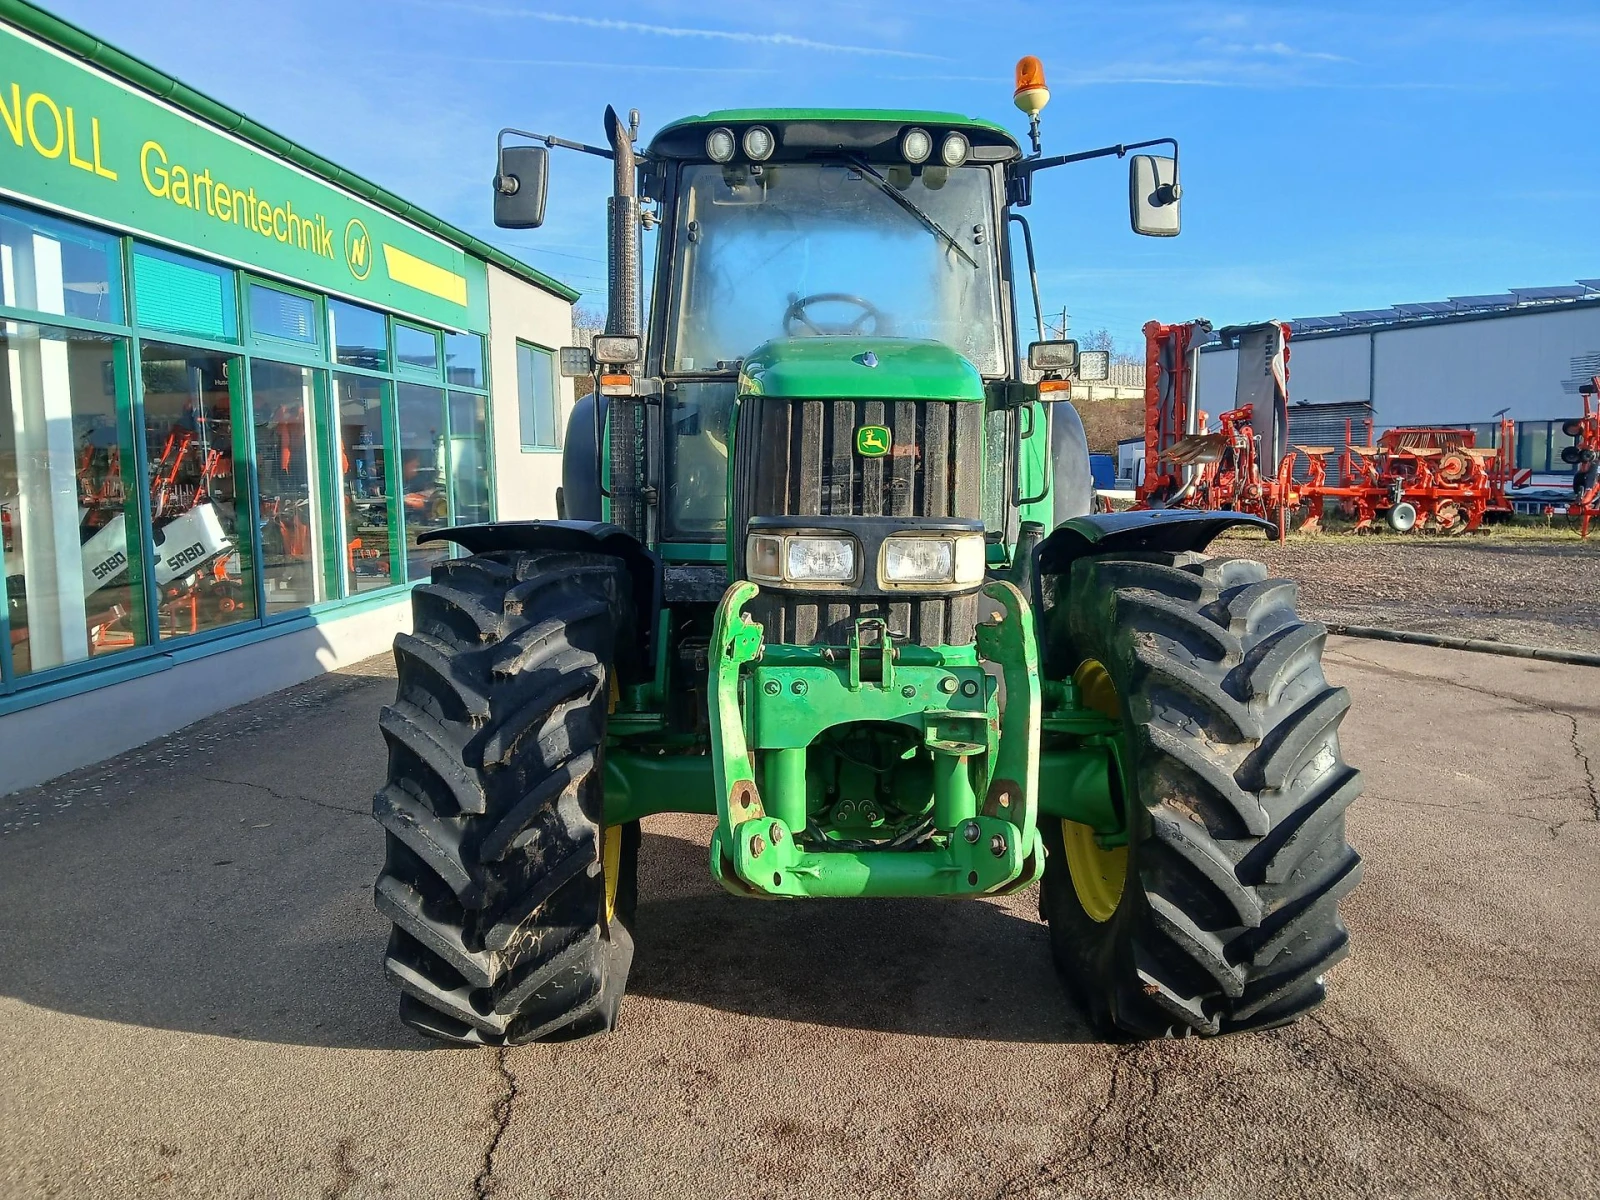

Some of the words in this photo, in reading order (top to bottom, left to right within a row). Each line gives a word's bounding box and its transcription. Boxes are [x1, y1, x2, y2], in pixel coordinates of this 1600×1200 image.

[140, 140, 335, 260] Gartentechnik
[1264, 334, 1274, 377] KUHN
[91, 551, 127, 580] SABO
[166, 541, 206, 572] SABO
